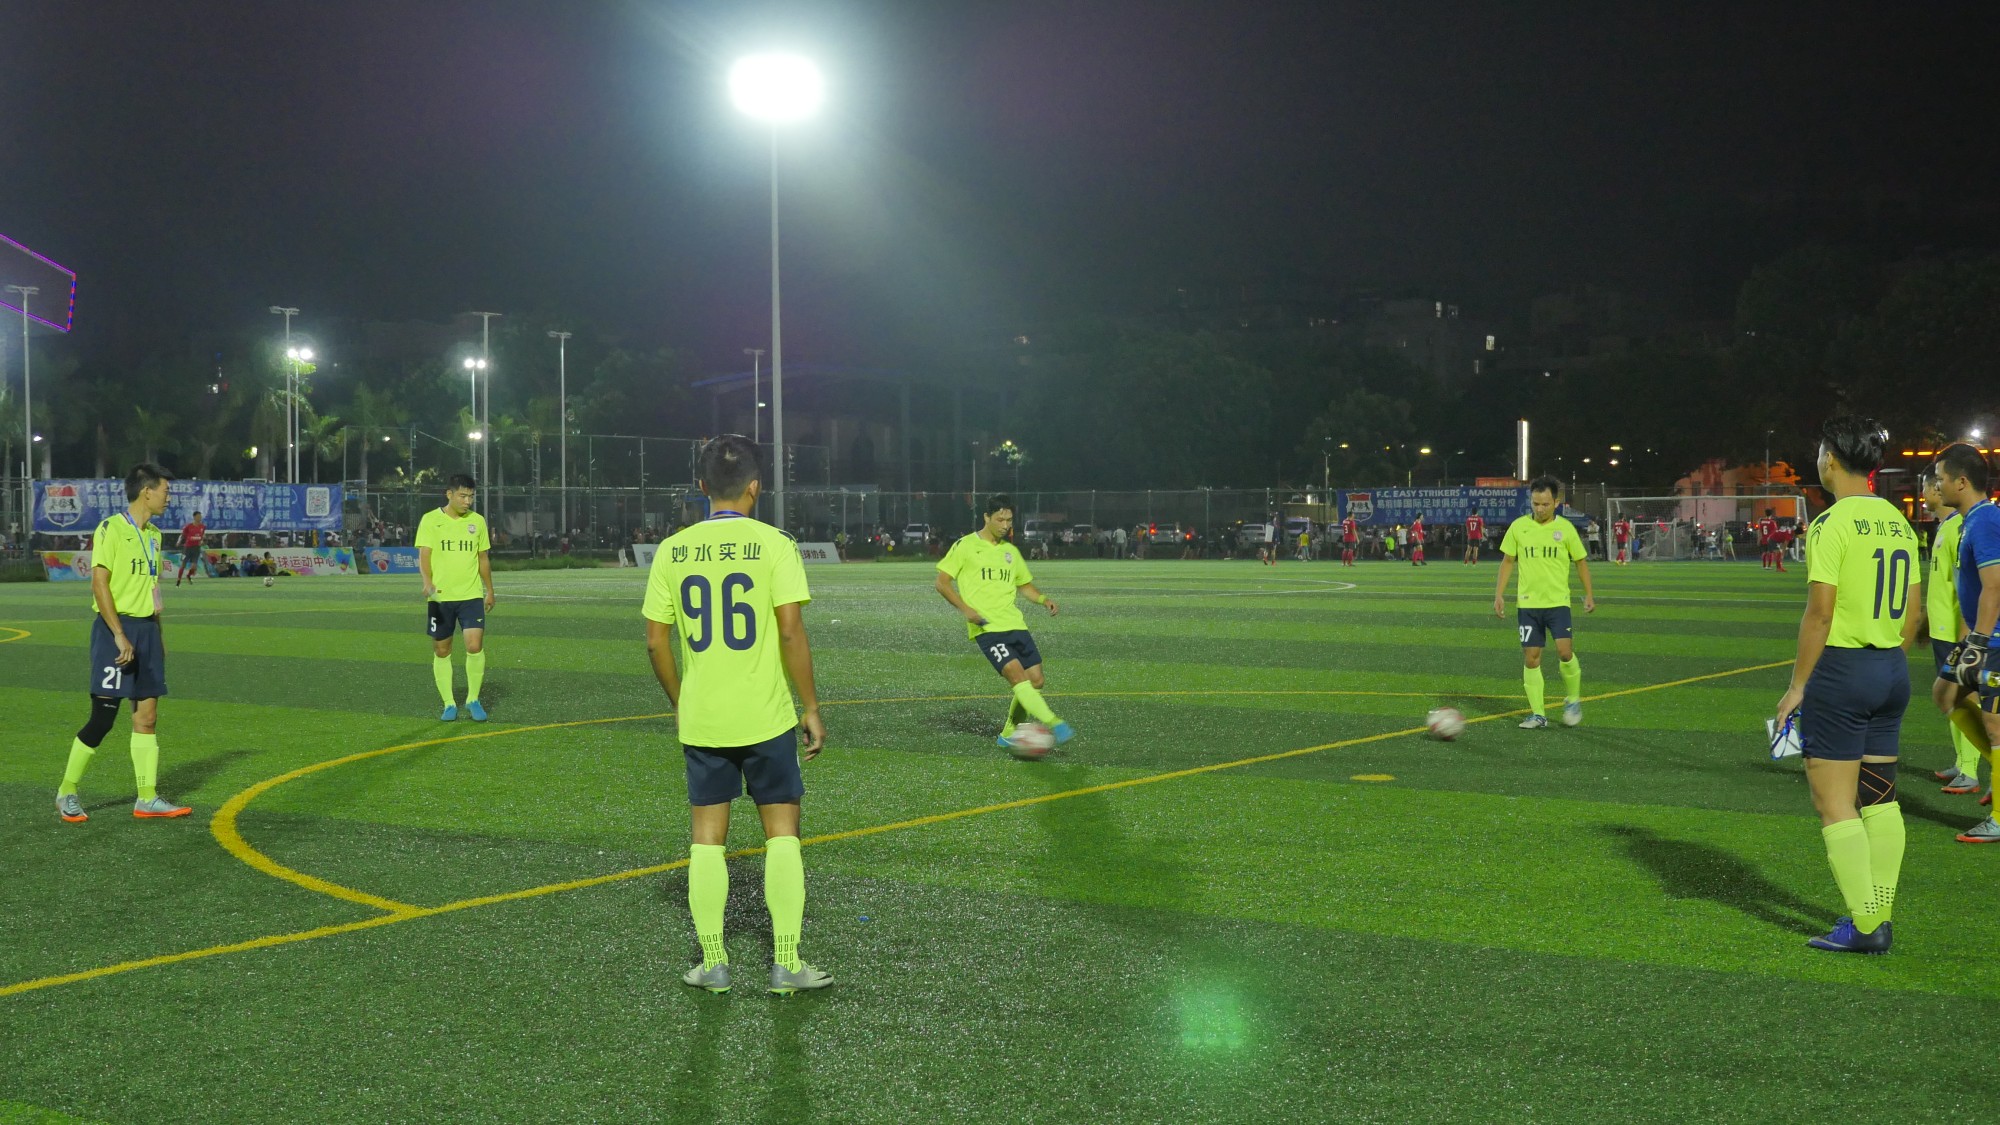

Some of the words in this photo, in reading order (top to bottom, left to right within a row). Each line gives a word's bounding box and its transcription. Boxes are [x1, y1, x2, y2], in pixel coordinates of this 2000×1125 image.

[202, 483, 255, 495] MAOMING
[1393, 490, 1417, 498] EASY
[1418, 489, 1460, 497] STRIKERS
[1469, 489, 1518, 497] MAOMING
[1854, 519, 1913, 540] 妙水实业
[672, 543, 761, 563] 妙水实业
[1872, 548, 1910, 620] 10
[680, 572, 757, 653] 96
[431, 616, 437, 632] 5
[1519, 625, 1533, 643] 97
[990, 643, 1010, 663] 33
[101, 666, 122, 690] 21
